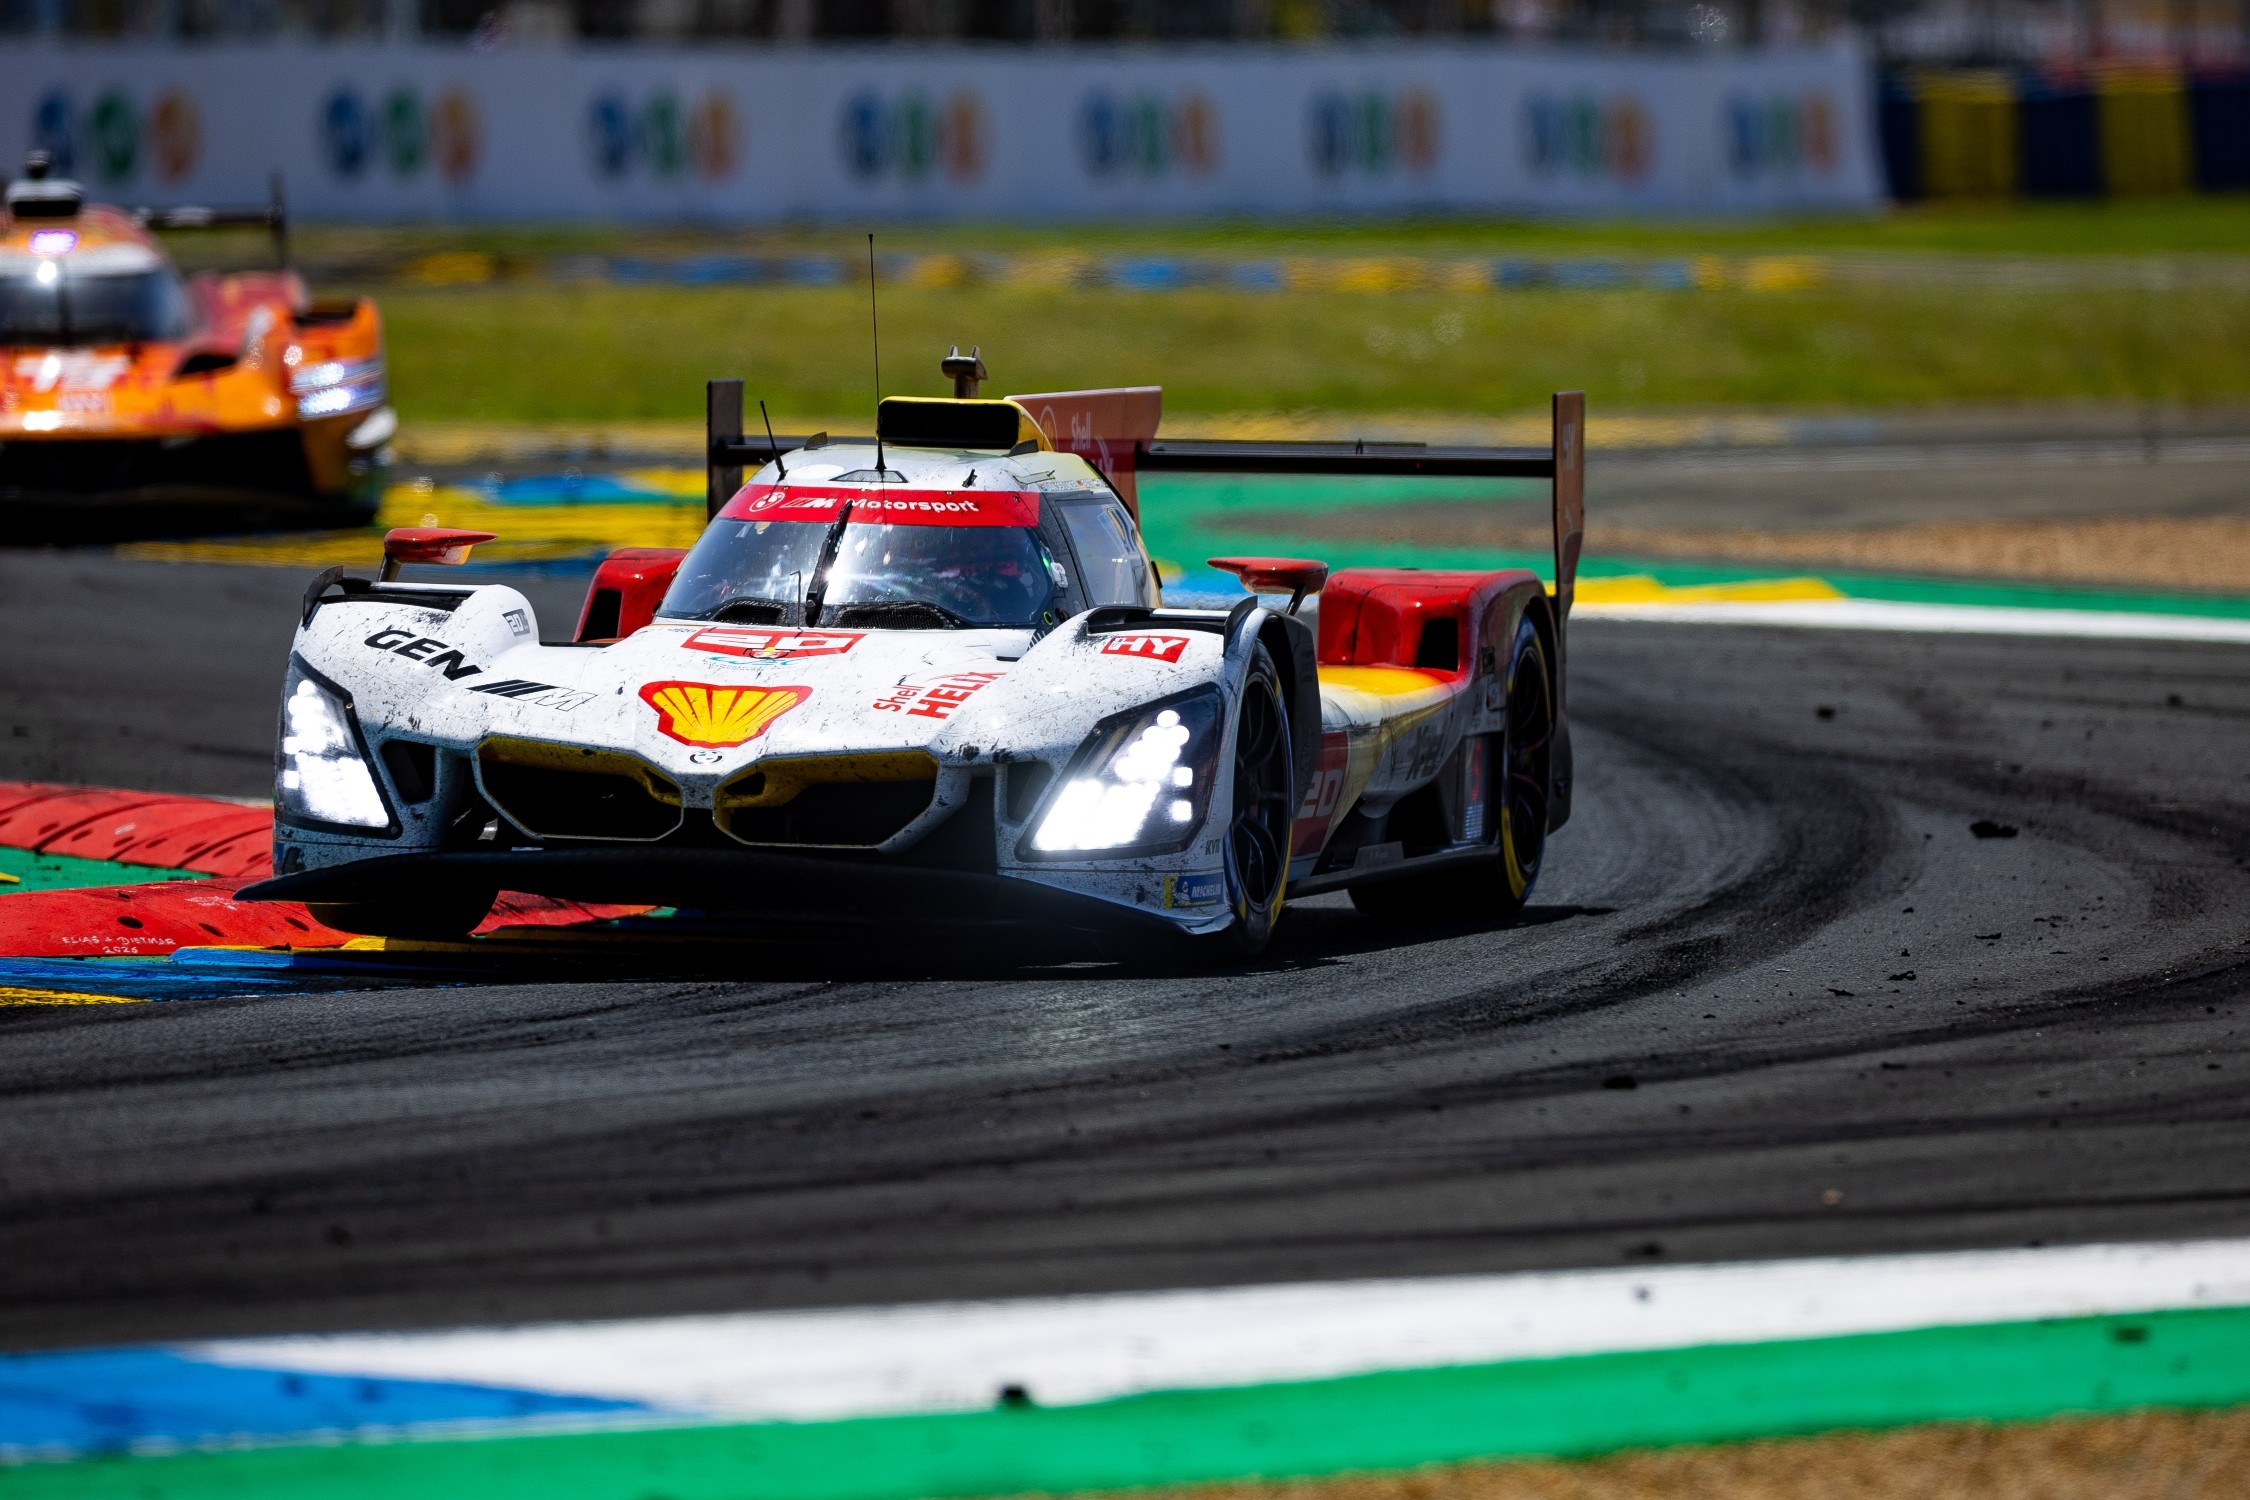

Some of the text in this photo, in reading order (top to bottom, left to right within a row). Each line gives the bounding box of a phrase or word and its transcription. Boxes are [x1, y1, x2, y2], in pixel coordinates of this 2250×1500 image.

[846, 499, 979, 513] Motorsport
[507, 613, 525, 632] 20
[693, 632, 853, 651] 20
[1107, 637, 1185, 655] HY
[364, 629, 483, 681] GEN
[872, 684, 925, 712] Shell
[906, 671, 1008, 720] HELIX
[1298, 769, 1343, 818] 20
[61, 936, 100, 945] ELIAS
[102, 946, 139, 954] 2026
